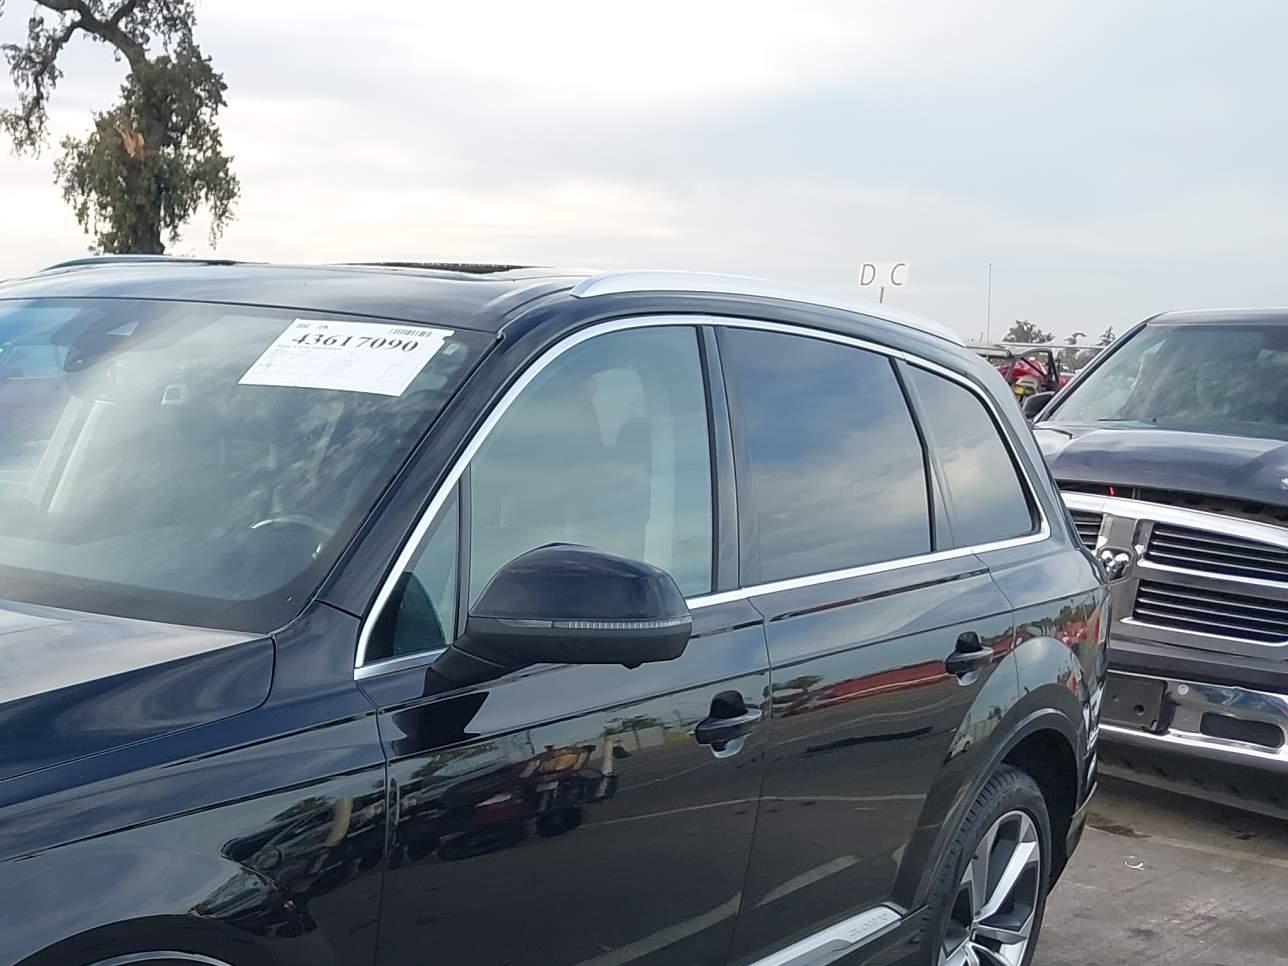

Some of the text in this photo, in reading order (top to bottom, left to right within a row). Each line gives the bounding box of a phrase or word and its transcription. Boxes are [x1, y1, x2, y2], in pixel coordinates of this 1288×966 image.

[860, 263, 906, 286] D C
[291, 333, 419, 352] 43617090
